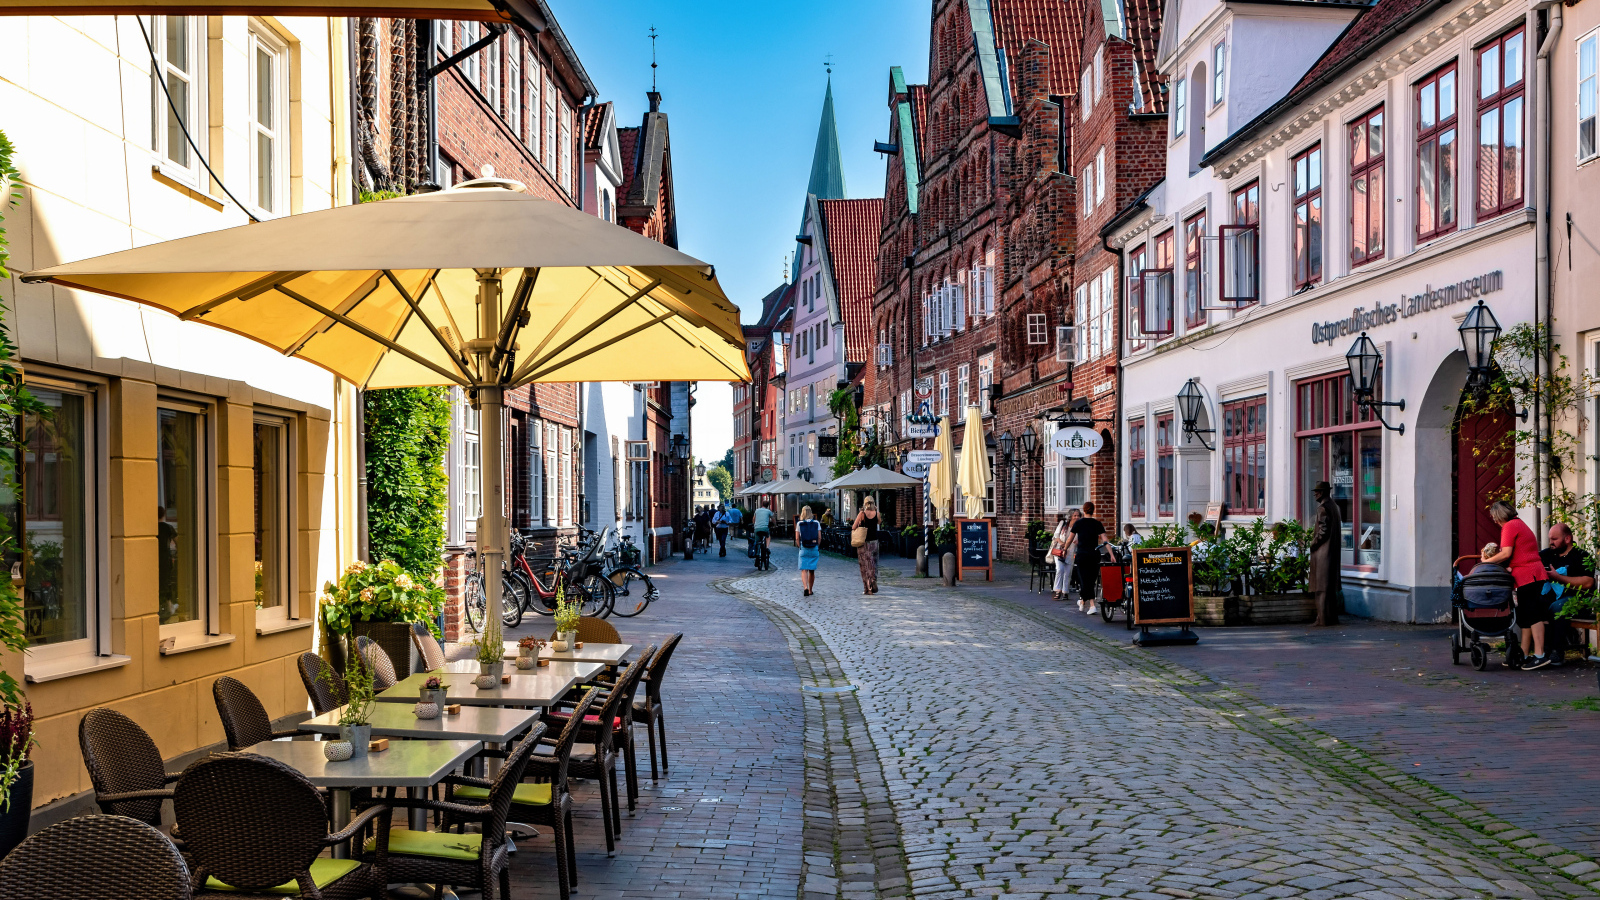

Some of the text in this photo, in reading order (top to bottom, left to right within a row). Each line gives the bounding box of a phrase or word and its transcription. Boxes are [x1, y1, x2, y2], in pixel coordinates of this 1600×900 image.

[1311, 269, 1503, 347] Ostpreußisches Landesmuseum
[910, 427, 940, 435] Biergartn
[1056, 437, 1098, 448] KRONE
